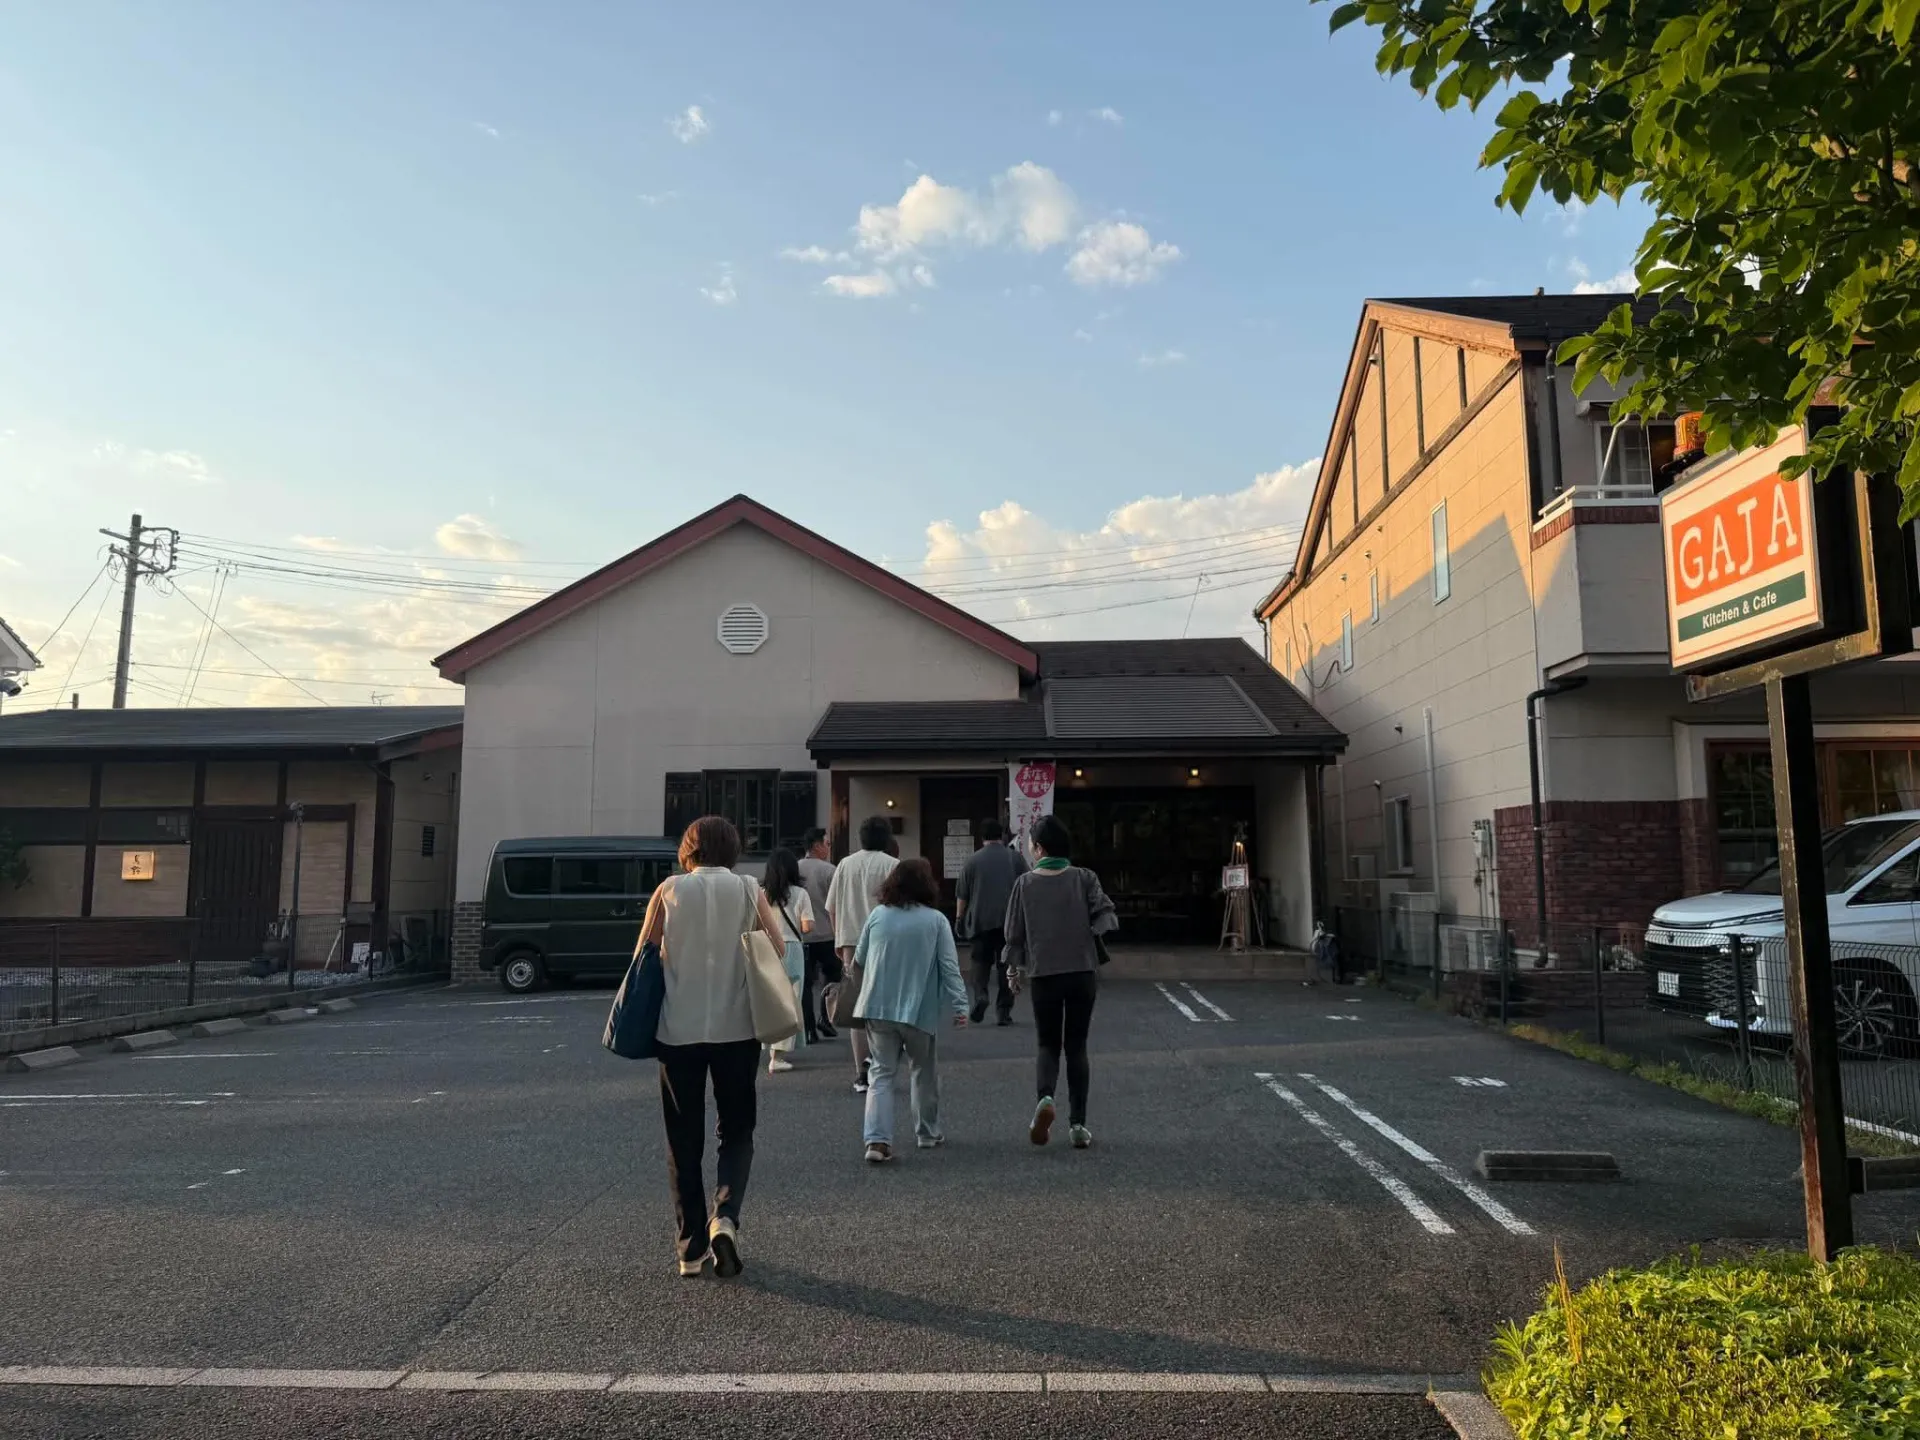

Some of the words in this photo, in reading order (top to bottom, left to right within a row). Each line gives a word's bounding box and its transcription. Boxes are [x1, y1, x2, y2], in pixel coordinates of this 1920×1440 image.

[1679, 483, 1797, 590] GAJA
[1702, 603, 1739, 629] Kitchen
[1742, 599, 1750, 615] &
[1753, 592, 1777, 611] Cafe
